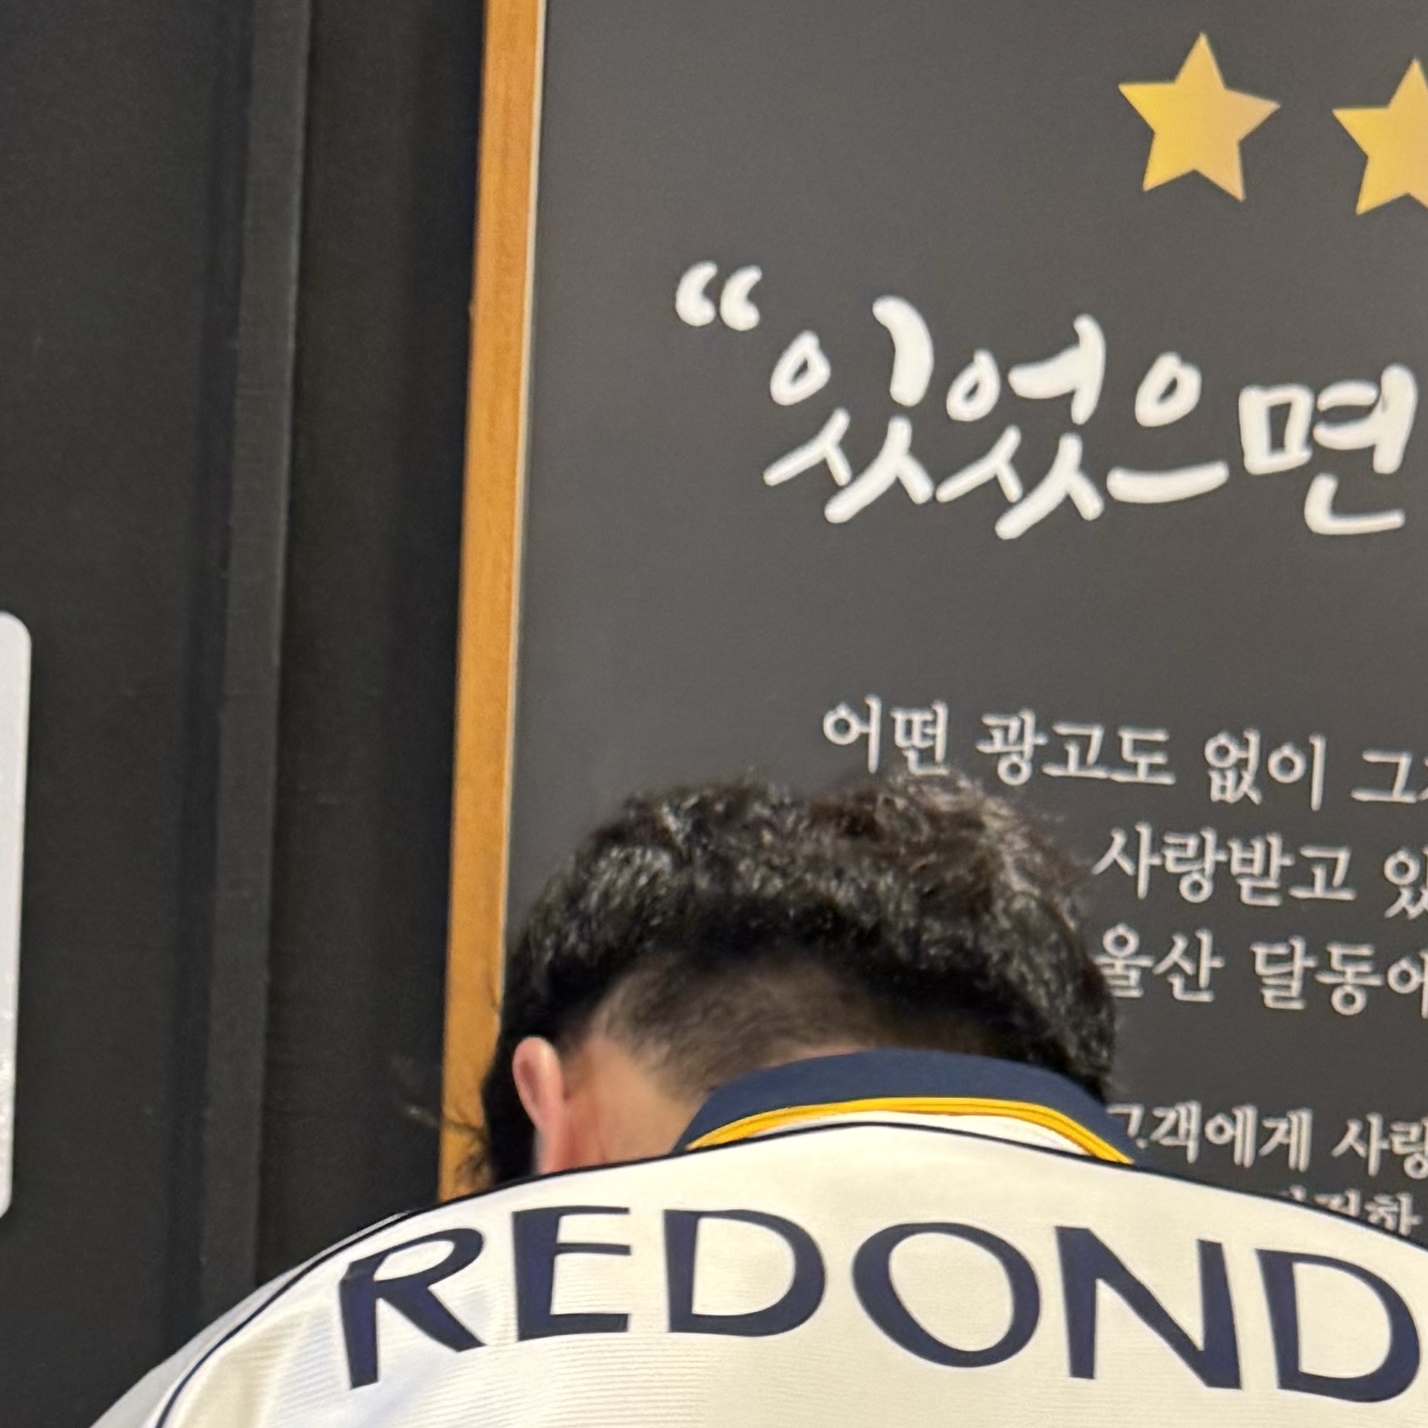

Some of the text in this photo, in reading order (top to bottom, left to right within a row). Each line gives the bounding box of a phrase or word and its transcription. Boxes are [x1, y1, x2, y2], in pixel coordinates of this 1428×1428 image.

[823, 696, 949, 776] 어떤
[976, 710, 1175, 786] 광고도
[1204, 730, 1326, 810] 없이
[1093, 823, 1355, 907] 사랑받고
[1095, 923, 1224, 1002] 울산
